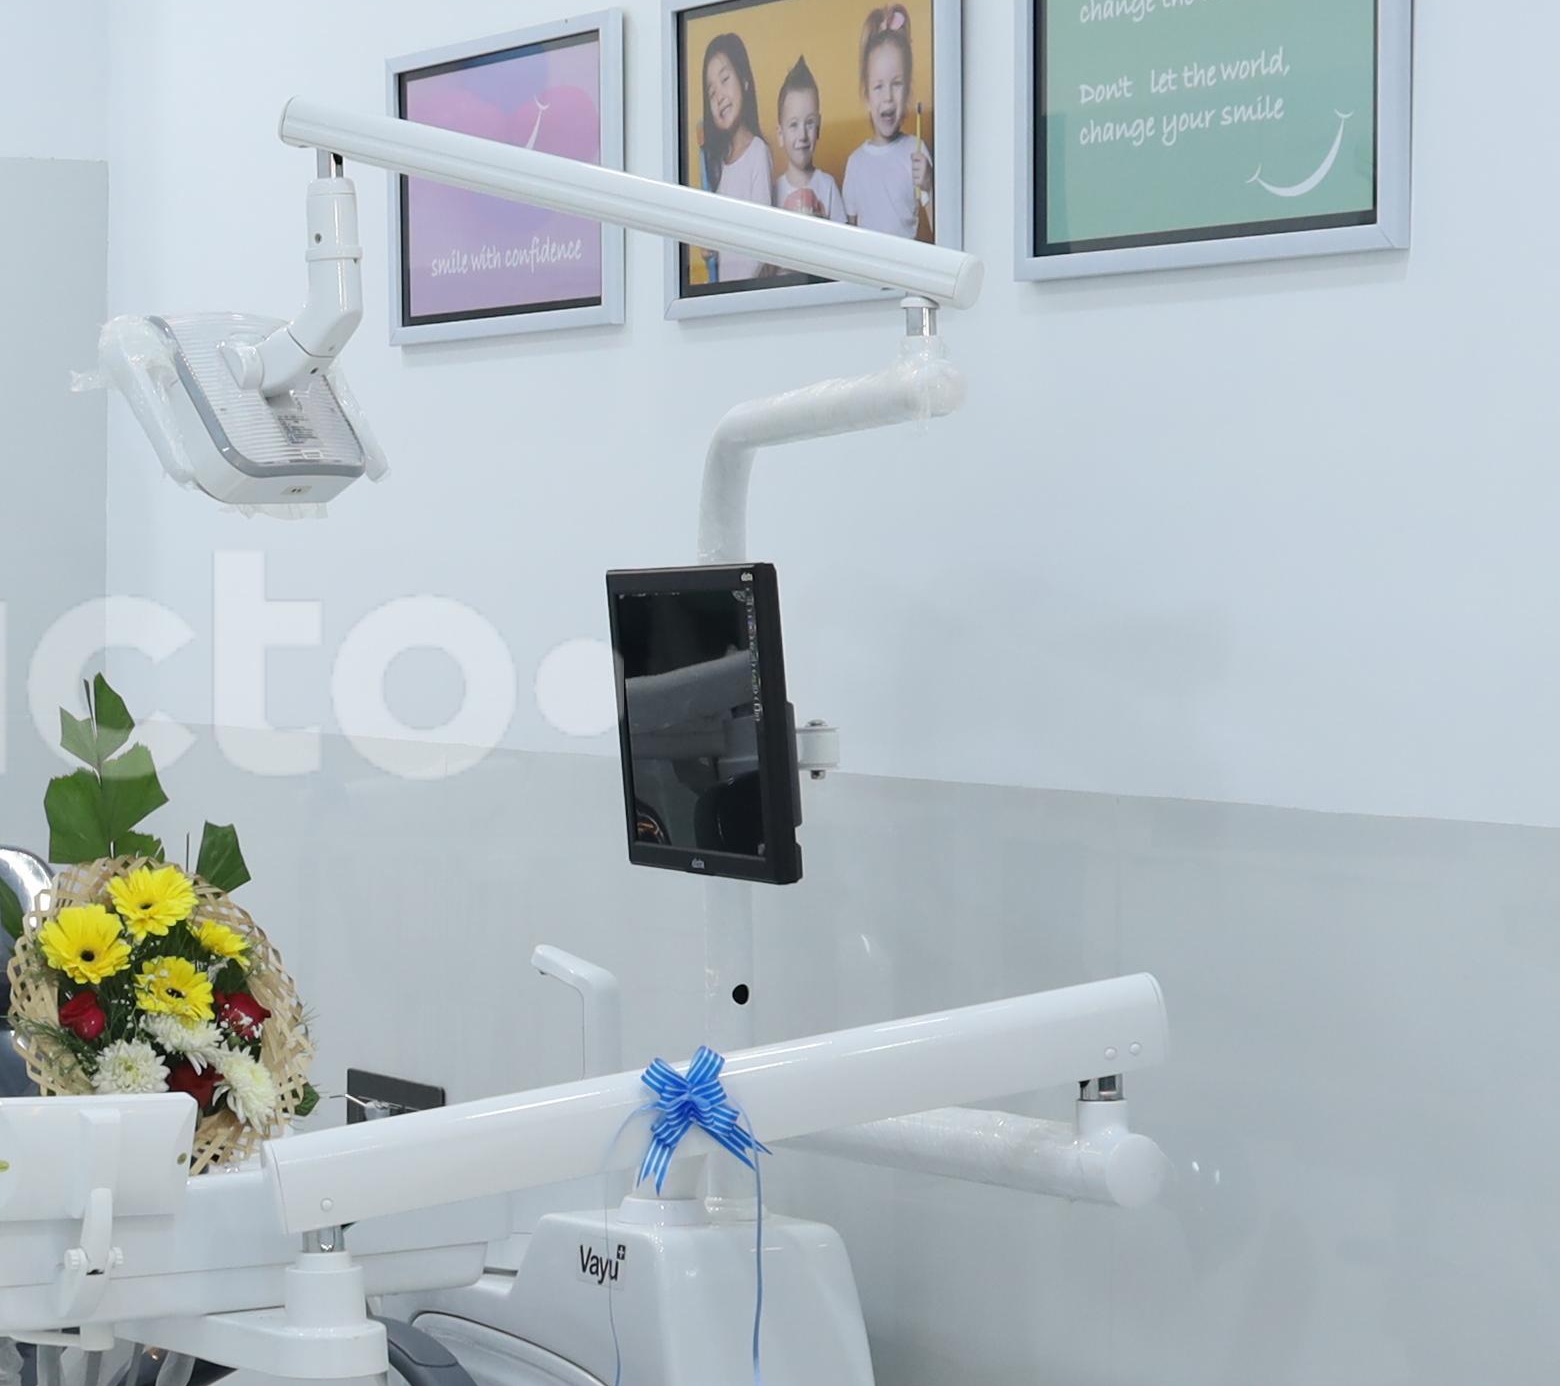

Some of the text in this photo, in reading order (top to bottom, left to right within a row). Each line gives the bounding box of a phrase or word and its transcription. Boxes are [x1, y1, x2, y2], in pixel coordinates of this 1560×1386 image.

[1079, 46, 1290, 104] Don't let the world,
[1080, 95, 1284, 146] change your smile
[432, 236, 582, 277] smile with confidence
[580, 1244, 619, 1285] Vayu
